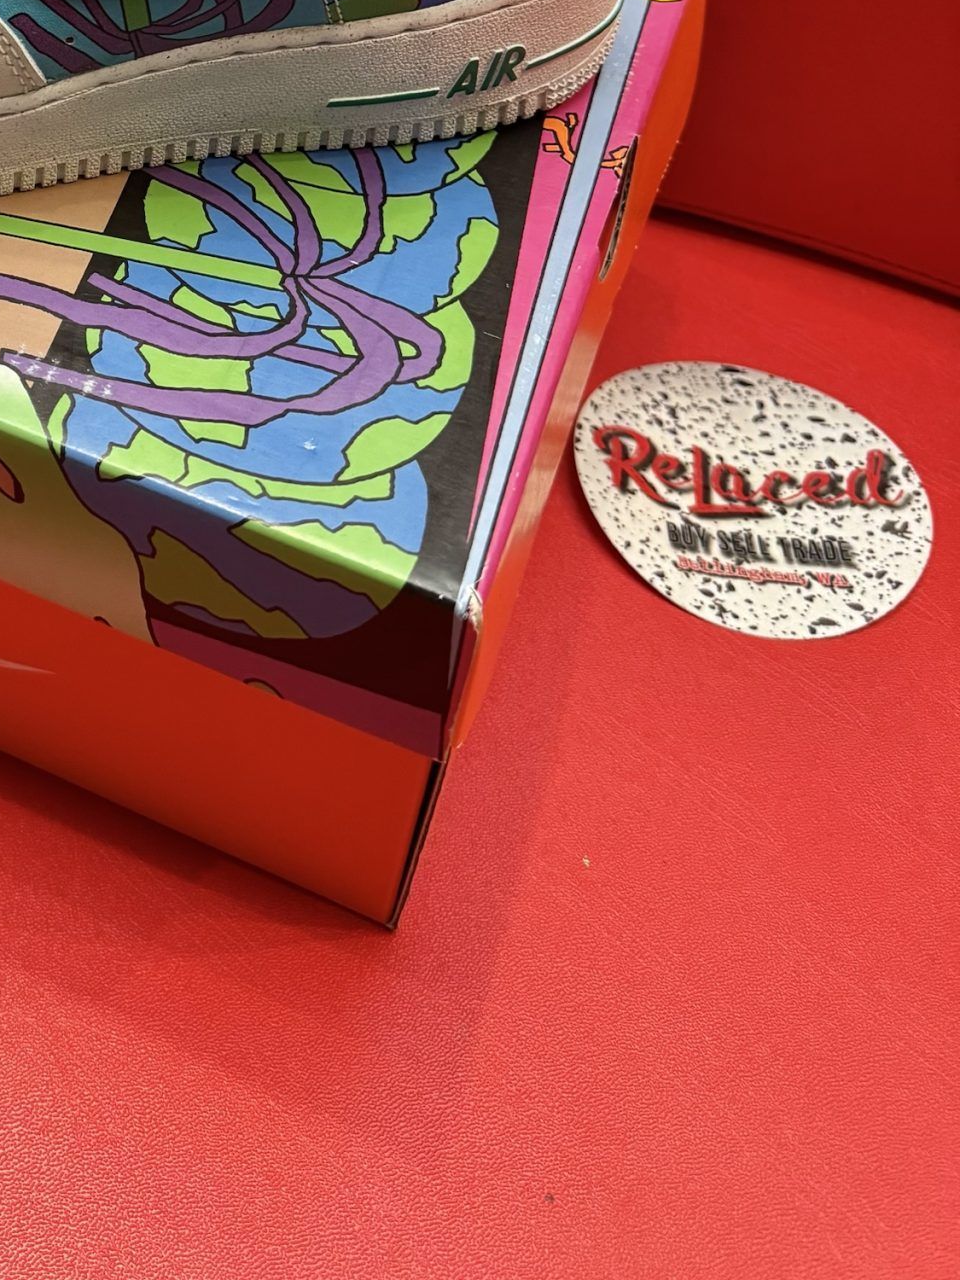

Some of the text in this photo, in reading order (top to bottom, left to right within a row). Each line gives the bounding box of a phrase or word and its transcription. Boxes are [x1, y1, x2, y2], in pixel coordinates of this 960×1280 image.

[445, 43, 528, 100] AIR
[666, 521, 853, 564] BUY SELL TRADE
